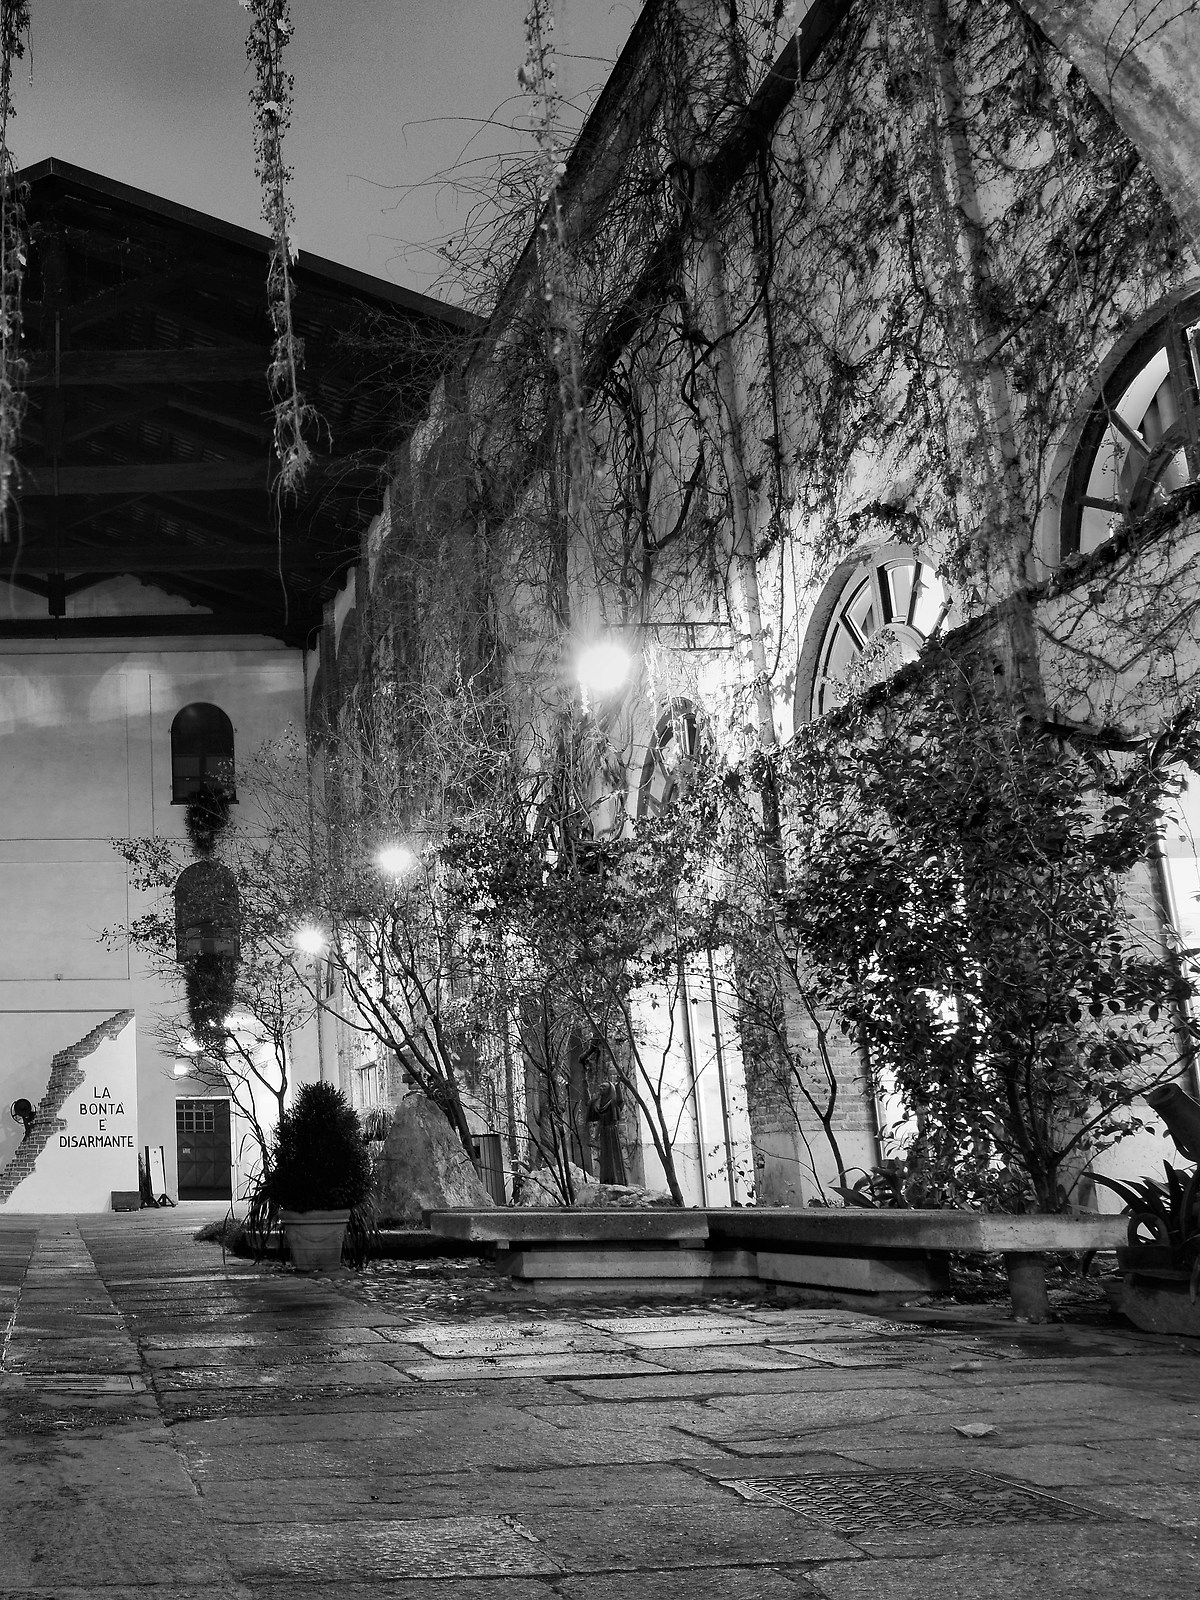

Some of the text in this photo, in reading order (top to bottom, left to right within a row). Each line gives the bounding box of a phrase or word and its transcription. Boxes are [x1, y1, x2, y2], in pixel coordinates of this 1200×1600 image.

[94, 1086, 111, 1099] LA
[79, 1102, 125, 1115] BONTÀ
[59, 1135, 134, 1148] DISARMANTE
